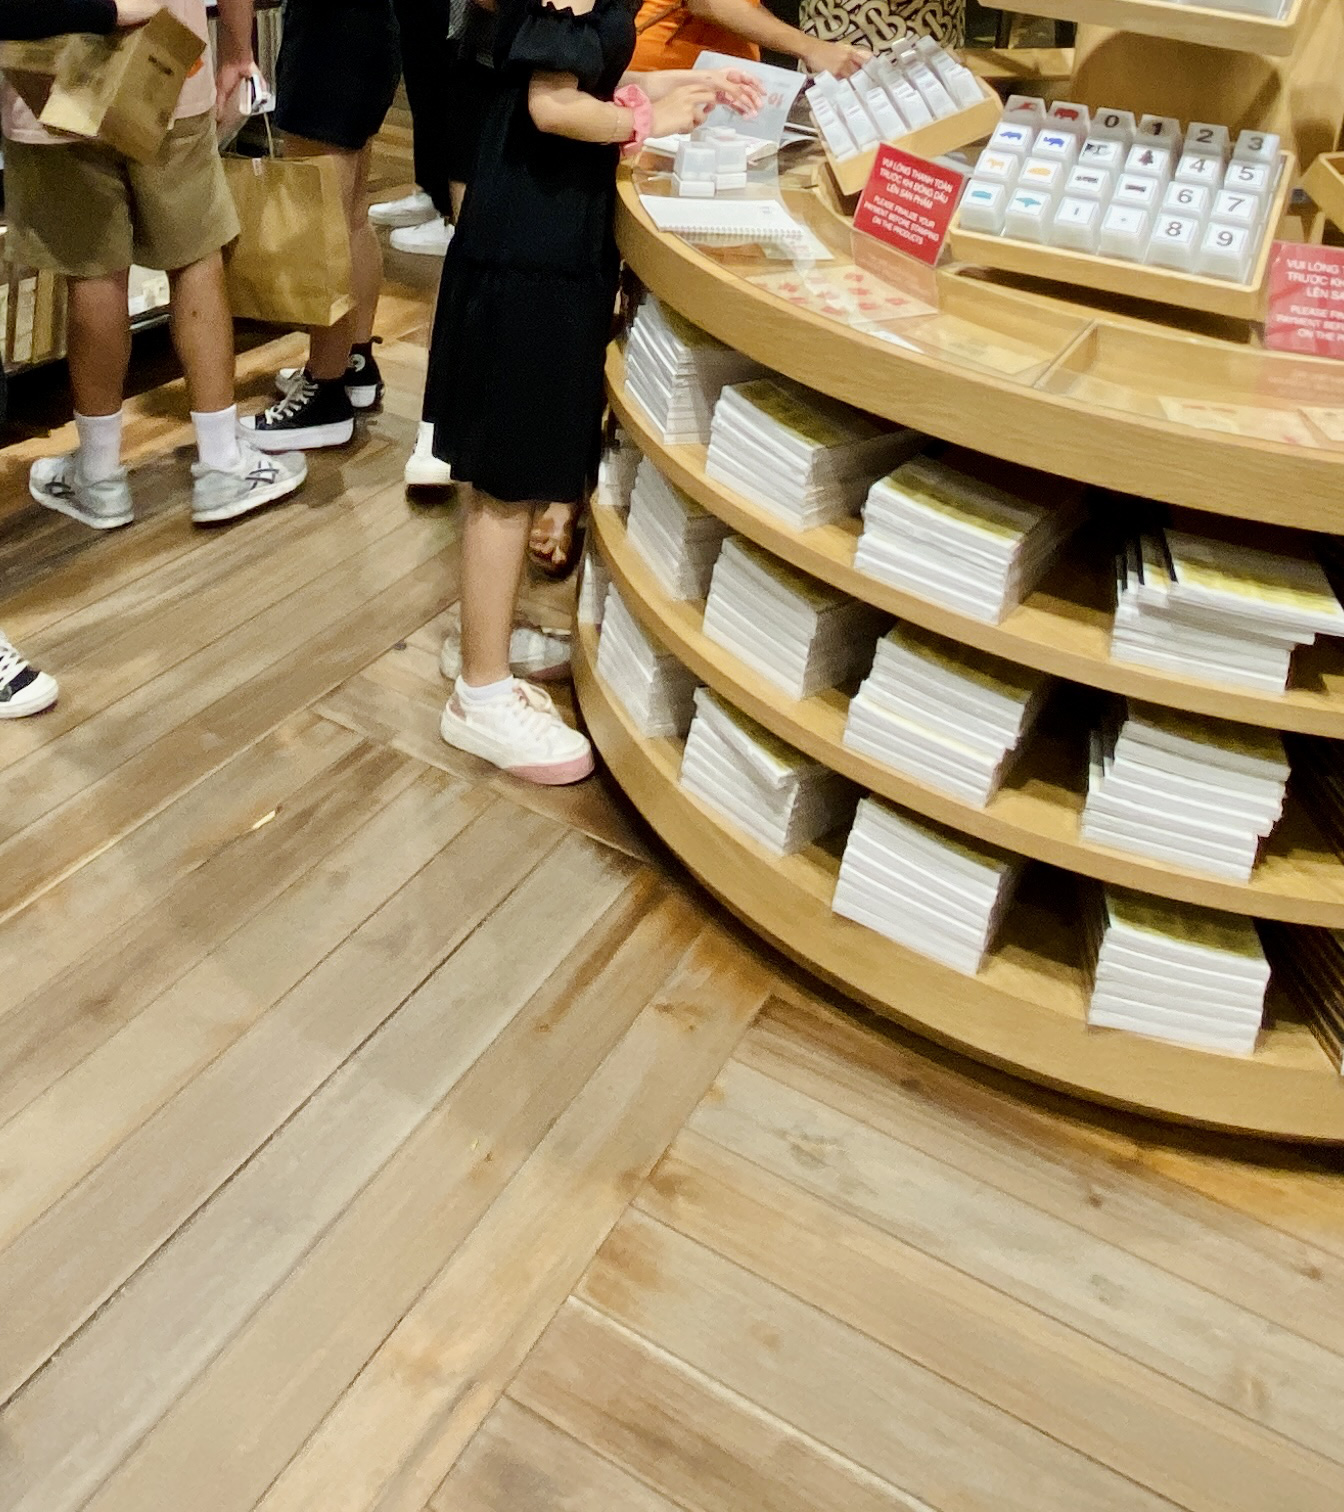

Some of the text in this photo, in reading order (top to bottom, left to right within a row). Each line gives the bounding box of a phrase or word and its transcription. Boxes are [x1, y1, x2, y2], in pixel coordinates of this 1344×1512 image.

[1105, 114, 1120, 128] 0
[1151, 122, 1163, 136] 1
[1196, 129, 1214, 144] 2
[1248, 137, 1264, 151] 3
[1189, 158, 1206, 173] 4
[1238, 166, 1256, 181] 5
[1177, 188, 1194, 204] 6
[1227, 196, 1246, 213] 7
[1165, 221, 1182, 237] 8
[1216, 231, 1234, 247] 9
[1286, 258, 1306, 270] VUI
[1290, 305, 1329, 318] PLEASE
[1296, 328, 1314, 339] ON
[1316, 330, 1335, 341] THE
